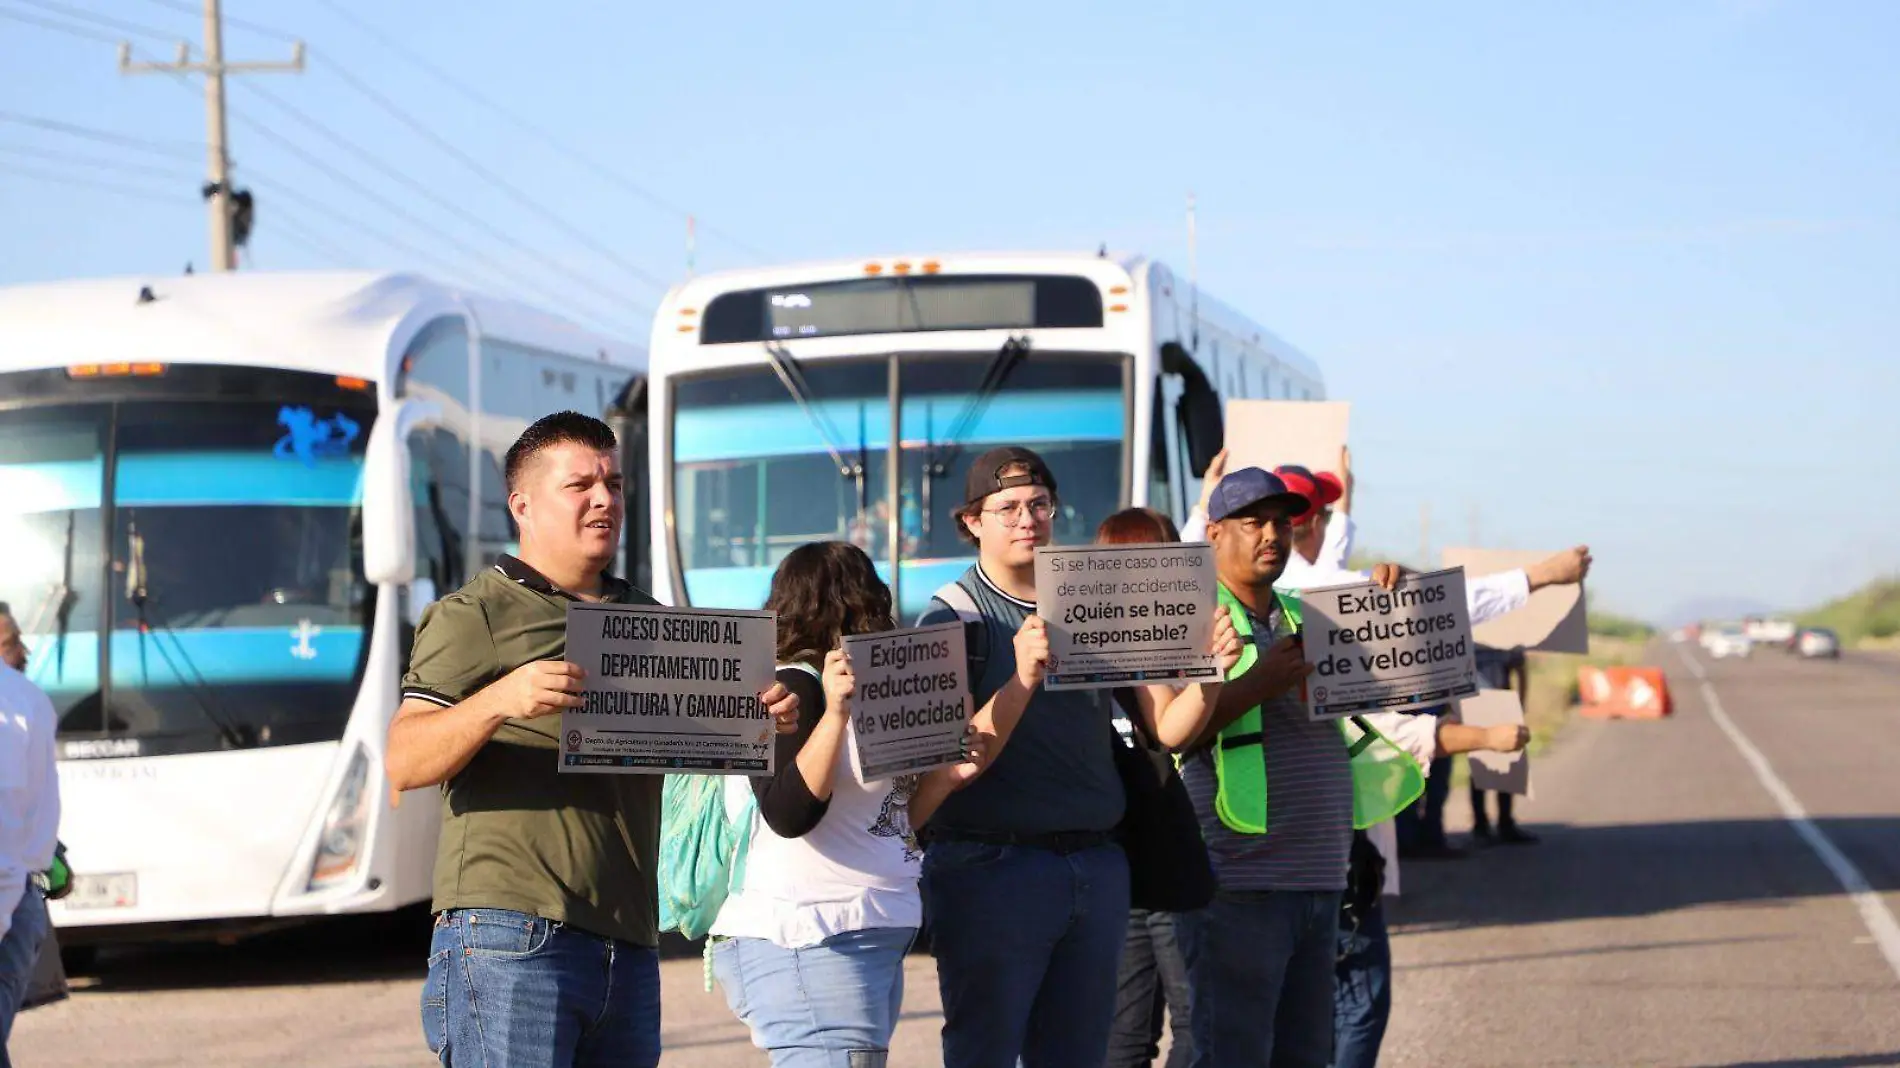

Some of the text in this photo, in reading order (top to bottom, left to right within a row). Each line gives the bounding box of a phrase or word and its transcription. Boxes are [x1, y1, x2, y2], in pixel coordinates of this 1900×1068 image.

[1051, 552, 1202, 572] Si se hace caso omiso
[1057, 577, 1201, 597] de evitar accidentes,
[1337, 584, 1446, 616] Exigimos
[1064, 600, 1196, 624] ¿Quién se hace
[602, 615, 742, 645] ACCESO SEGURO AL
[1072, 624, 1188, 648] responsable?
[1328, 612, 1456, 646] reductores
[601, 653, 742, 682] DEPARTAMENTO DE
[870, 637, 949, 669] Exigimos
[1317, 635, 1467, 676] de velocidad
[861, 671, 957, 702] reductores
[674, 693, 684, 717] Y
[687, 691, 770, 720] GANADERÍA
[856, 696, 965, 736] de velocidad
